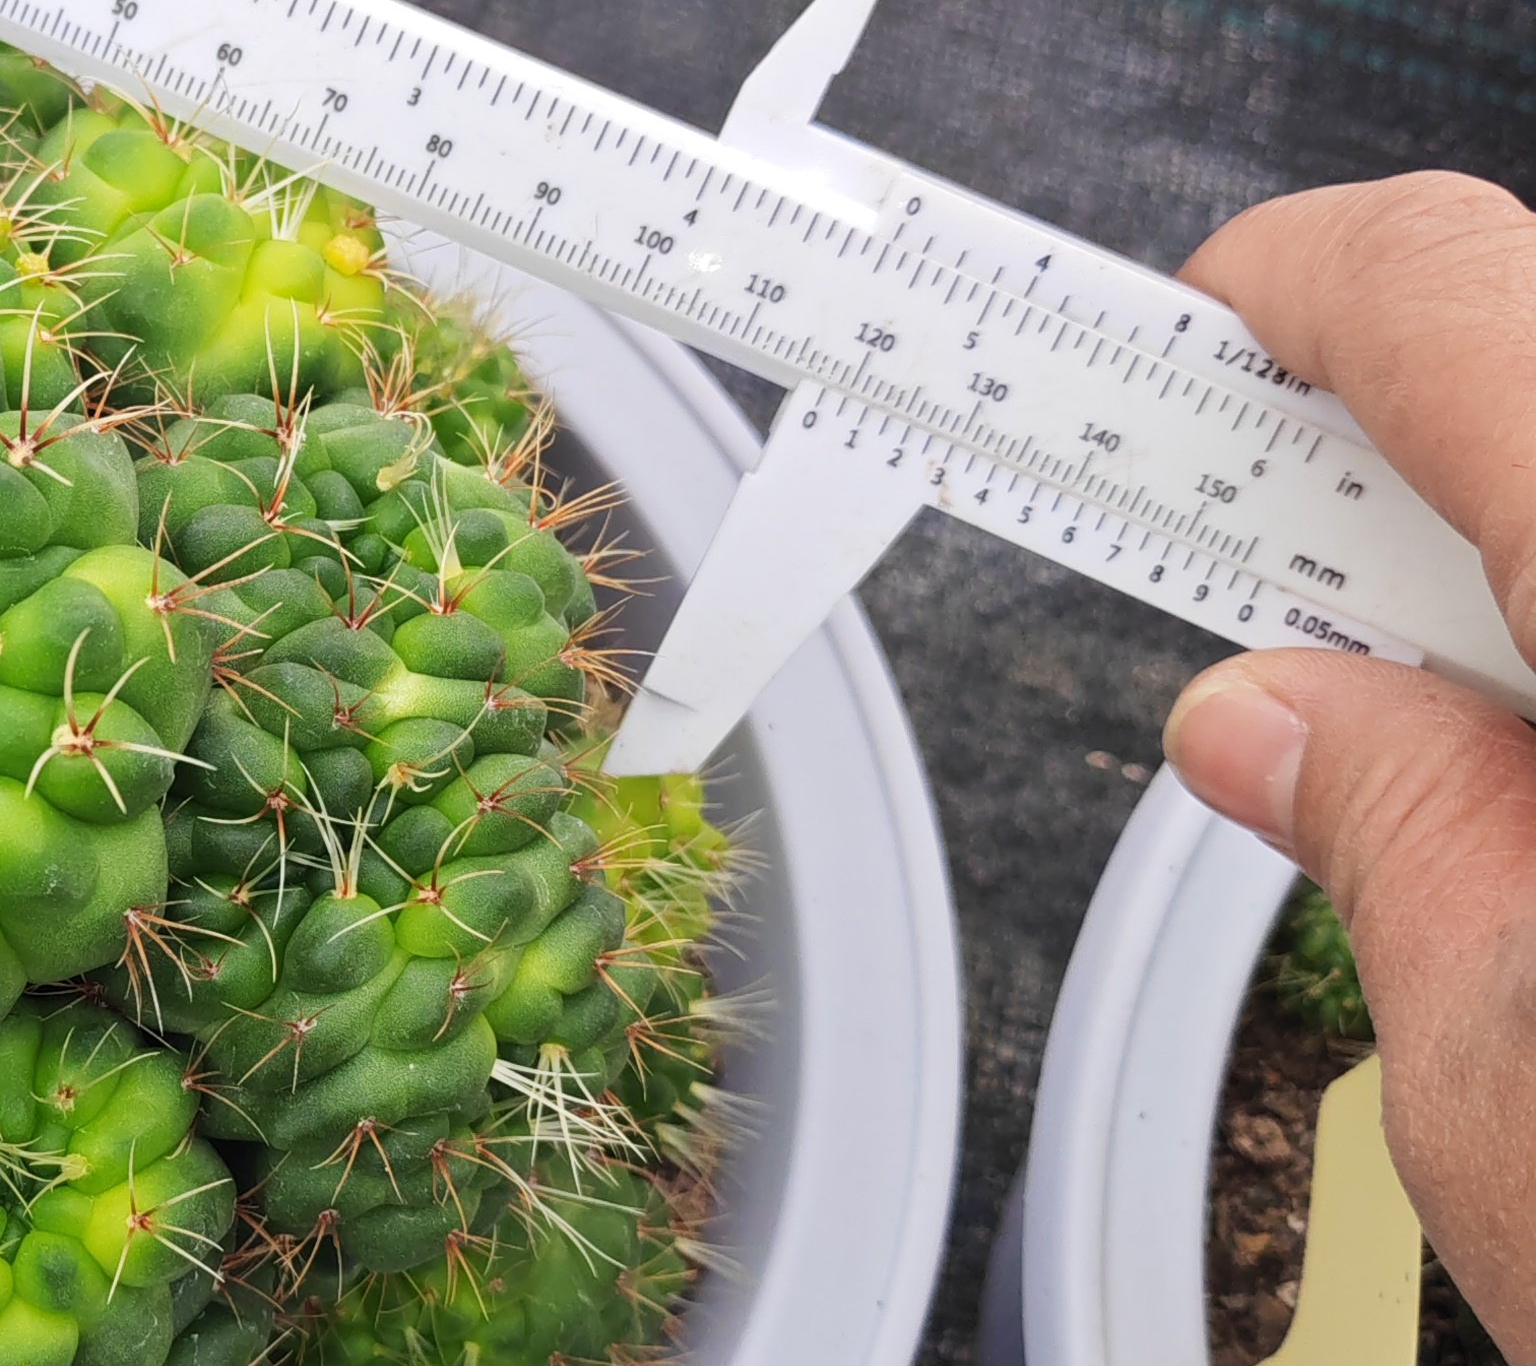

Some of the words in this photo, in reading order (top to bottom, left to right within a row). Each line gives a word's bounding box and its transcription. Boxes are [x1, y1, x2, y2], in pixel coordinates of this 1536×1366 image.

[216, 42, 243, 67] 60
[322, 87, 349, 113] 70
[425, 134, 453, 159] 80
[533, 181, 562, 206] 90
[633, 225, 675, 257] 100
[744, 274, 786, 305] 110
[855, 323, 896, 353] 120
[967, 372, 1009, 403] 130
[1079, 423, 1121, 454] 140
[1195, 474, 1238, 506] 150
[1289, 554, 1346, 590] mm
[406, 87, 422, 107] 3
[683, 209, 699, 227] 4
[963, 331, 979, 350] 5
[1250, 459, 1267, 478] 6
[1336, 472, 1365, 499] in
[906, 196, 922, 216] 0
[1035, 254, 1052, 272] 4
[1174, 313, 1192, 333] 8
[802, 410, 818, 430] 0
[844, 429, 859, 450] 1
[886, 448, 904, 468] 2
[930, 467, 946, 486] 3
[974, 488, 990, 505] 4
[1017, 505, 1034, 525] 5
[1062, 526, 1077, 544] 6
[1106, 544, 1123, 562] 7
[1149, 564, 1165, 583] 8
[1193, 584, 1210, 602] 9
[1237, 603, 1254, 623] 0
[1284, 607, 1371, 656] 0.05mm
